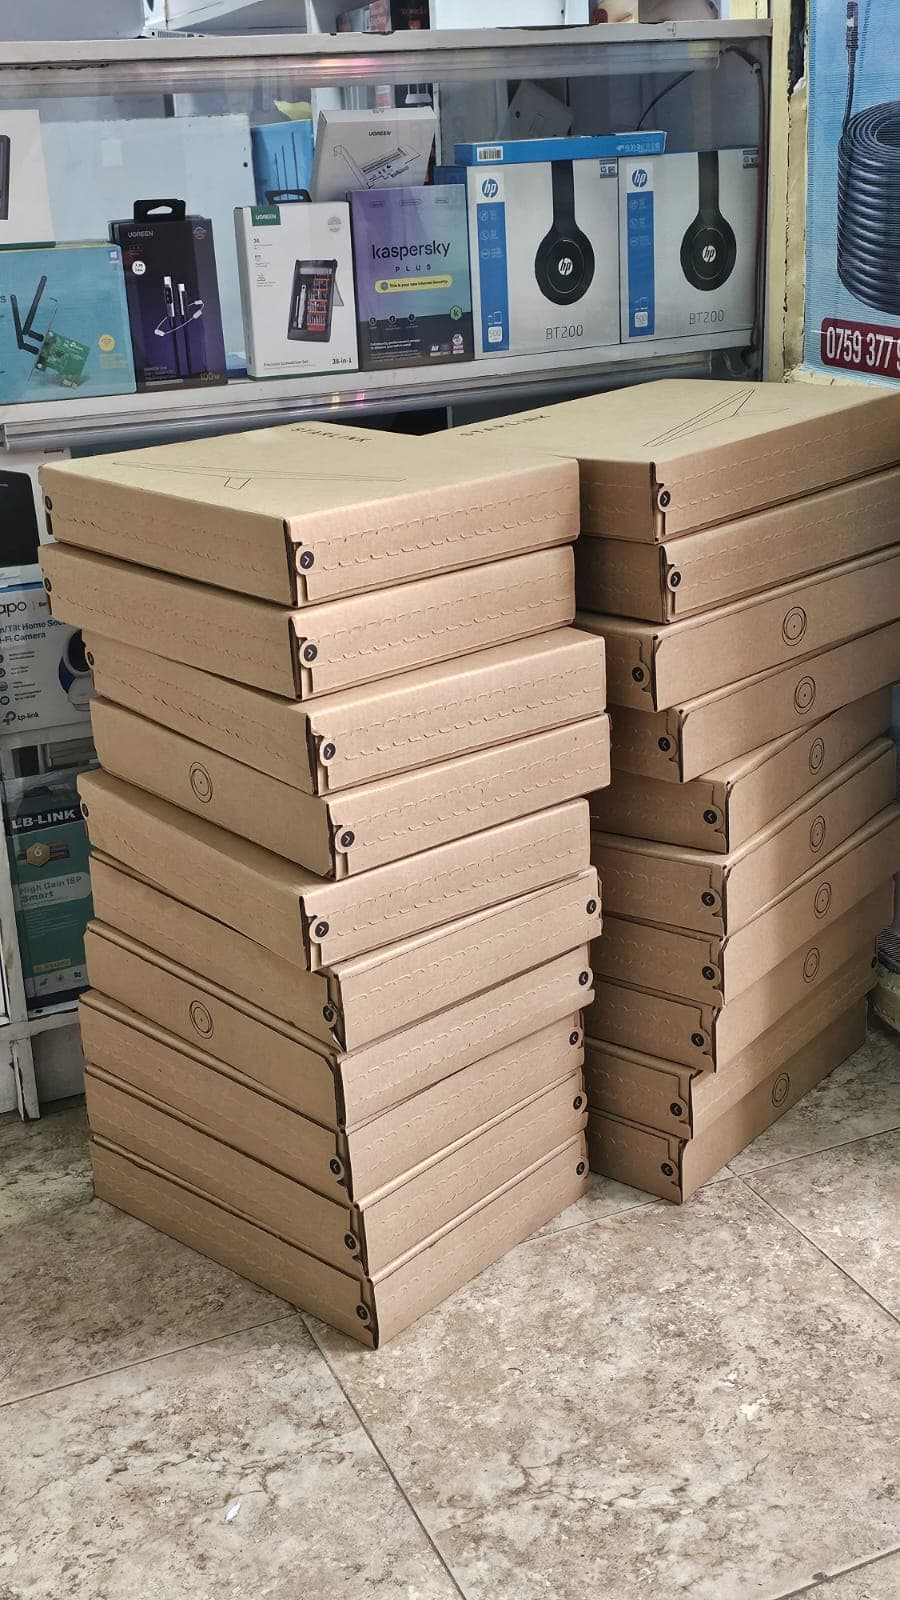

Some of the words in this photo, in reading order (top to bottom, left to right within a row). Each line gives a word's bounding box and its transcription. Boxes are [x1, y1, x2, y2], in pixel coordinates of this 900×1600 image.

[633, 169, 647, 187] hp
[482, 179, 498, 198] hp
[127, 230, 154, 238] UGREEN
[372, 240, 451, 260] kaspersky
[702, 245, 716, 262] hp
[395, 263, 432, 273] PLUS
[558, 257, 573, 275] hp
[689, 309, 725, 325] BT200
[545, 324, 584, 340] BT200
[826, 326, 862, 363] 0759
[866, 332, 894, 369] 377
[22, 622, 46, 630] Home
[14, 632, 46, 642] Camera
[17, 711, 40, 721] tp-link
[11, 809, 77, 829] LB-LINK
[21, 890, 54, 902] Smart
